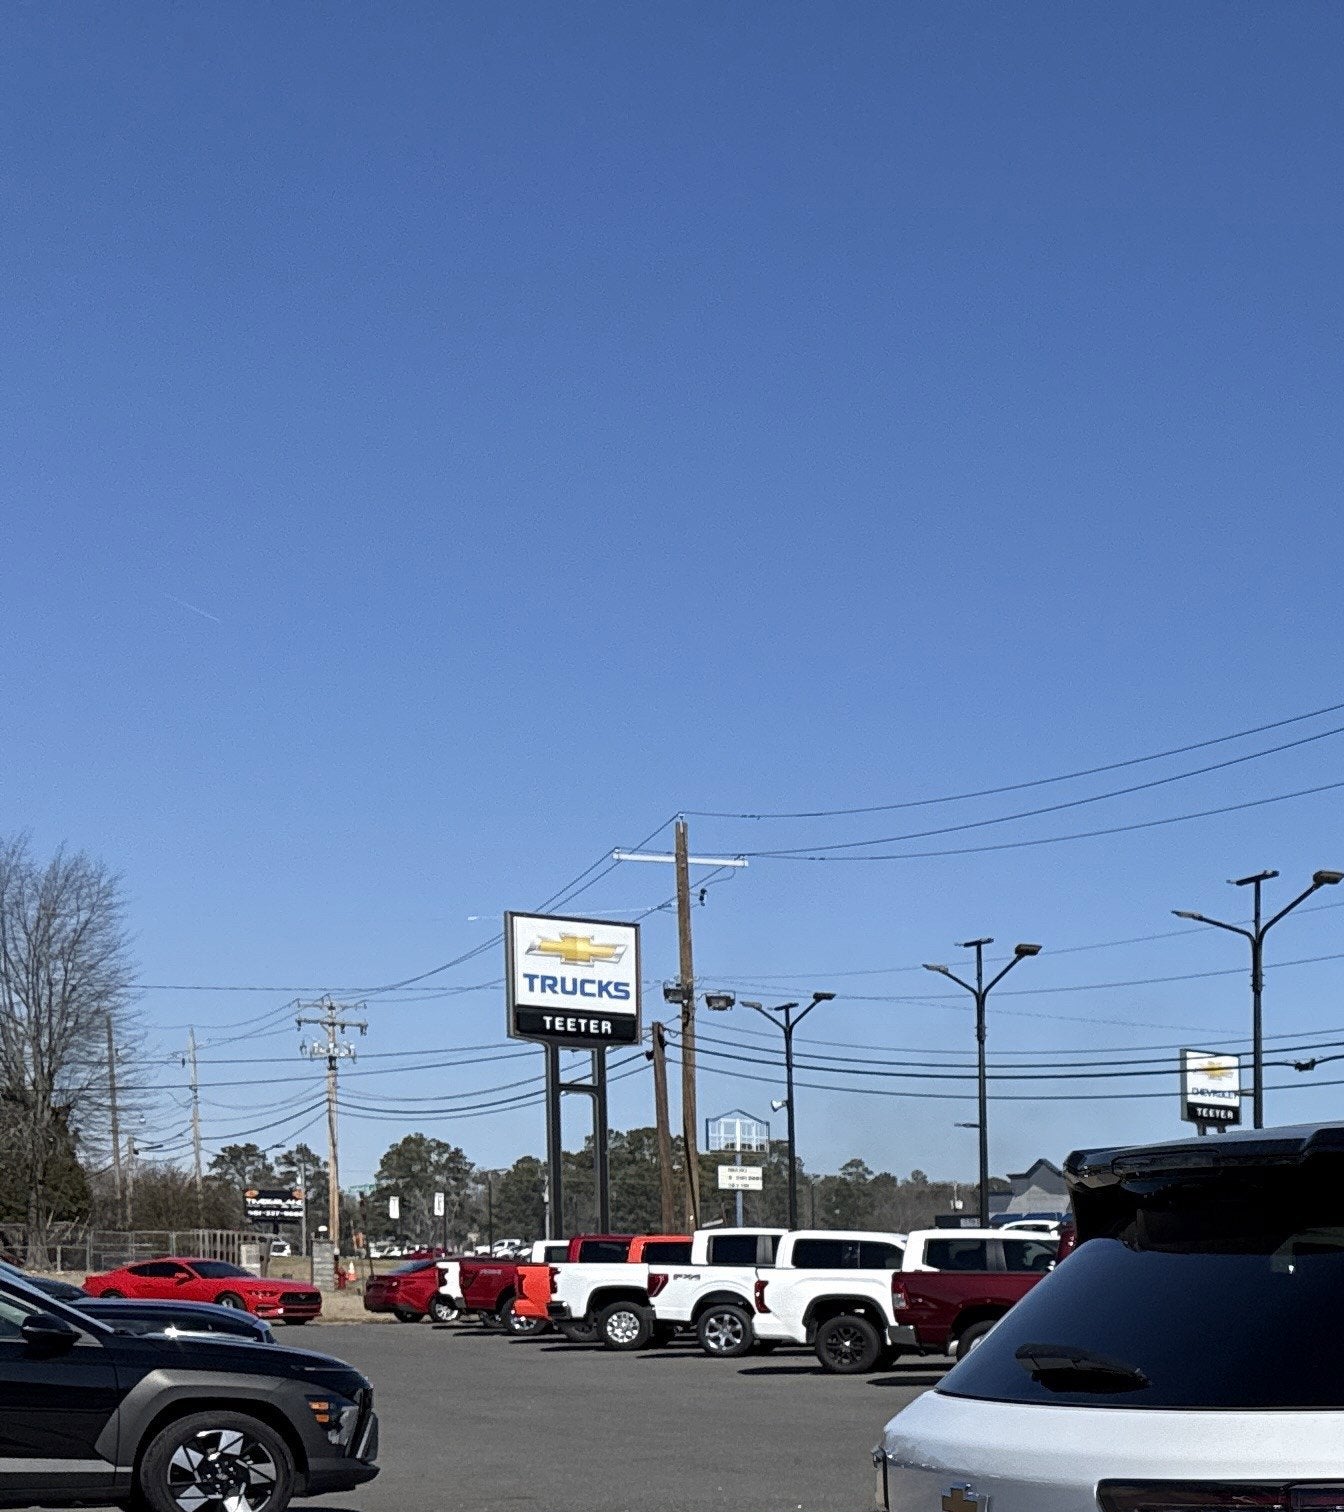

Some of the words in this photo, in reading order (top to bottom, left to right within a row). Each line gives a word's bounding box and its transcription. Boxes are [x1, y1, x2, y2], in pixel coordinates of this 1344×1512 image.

[522, 973, 631, 1000] TRUCKS
[543, 1016, 612, 1034] TEETER
[1196, 1107, 1234, 1119] TEETER
